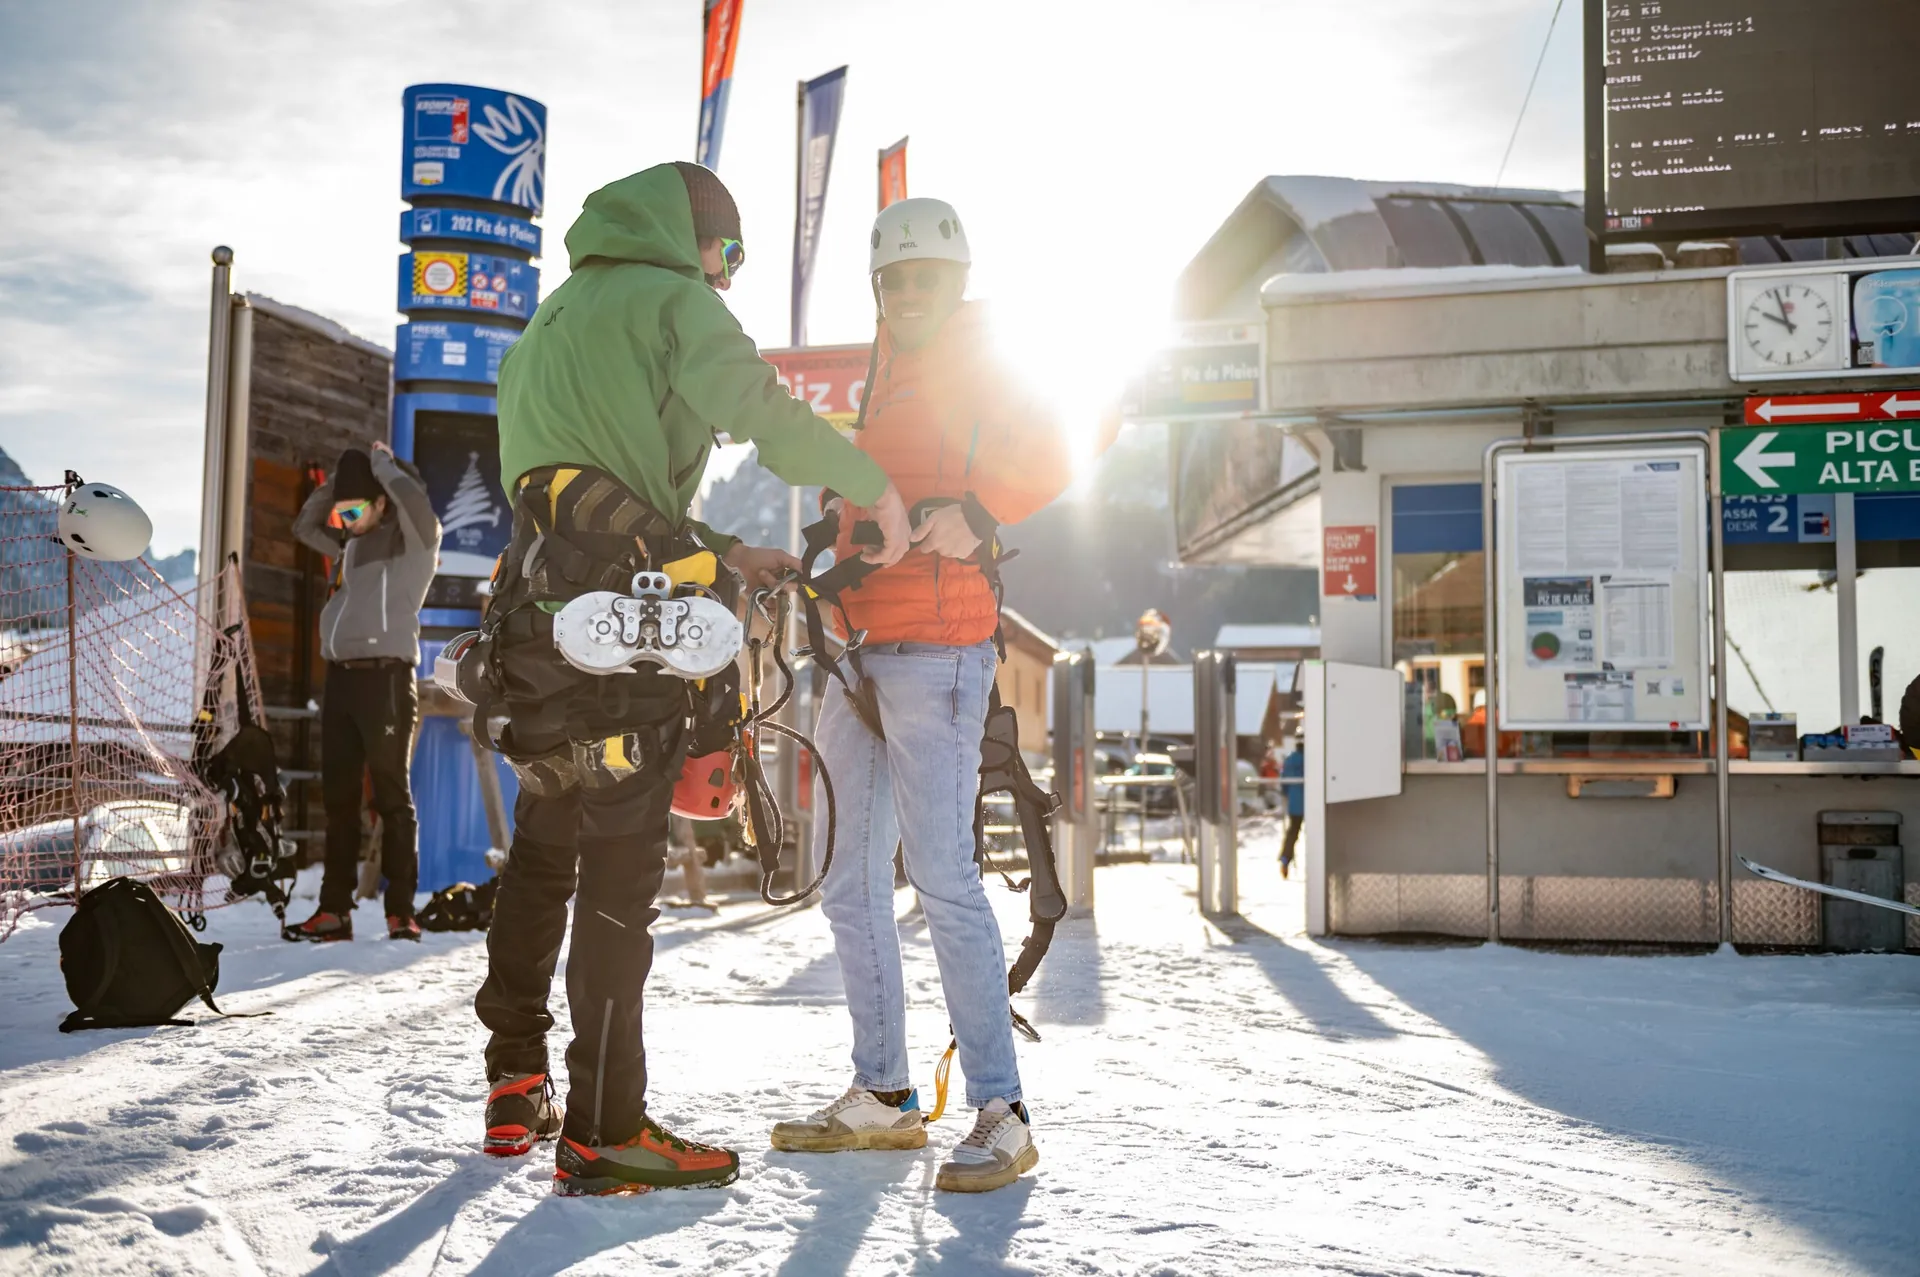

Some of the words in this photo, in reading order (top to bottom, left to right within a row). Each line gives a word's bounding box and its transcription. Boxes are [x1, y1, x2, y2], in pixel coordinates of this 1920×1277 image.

[451, 214, 473, 232] 202
[899, 241, 918, 251] PETZL
[1818, 459, 1899, 484] ALTA
[1726, 520, 1757, 532] DESK
[1767, 505, 1789, 533] 2
